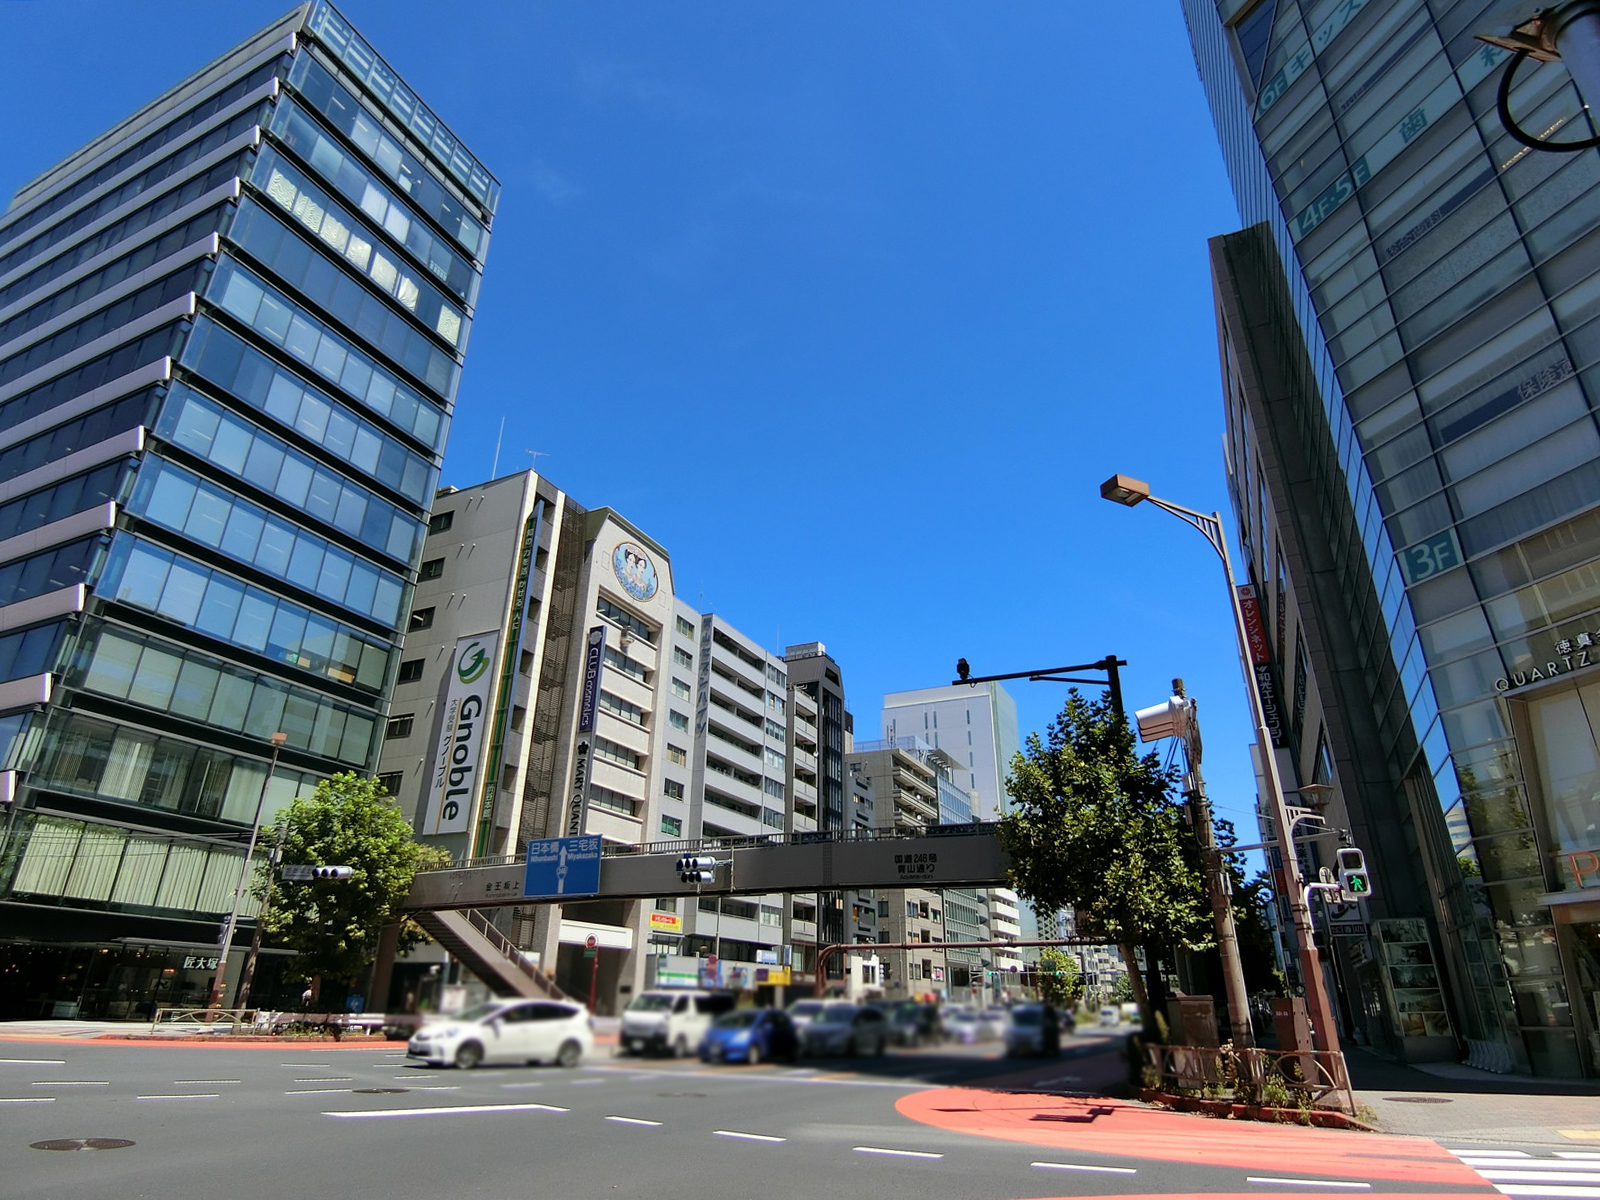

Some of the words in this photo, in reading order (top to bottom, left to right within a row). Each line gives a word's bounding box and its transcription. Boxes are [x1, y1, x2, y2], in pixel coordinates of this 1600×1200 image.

[1260, 74, 1286, 110] 6F
[1412, 542, 1454, 580] 3F
[1242, 599, 1265, 662] オレンジネット
[588, 647, 599, 680] CLUB
[1494, 651, 1591, 691] QUARTZ
[581, 680, 593, 727] cosmetics
[1257, 672, 1282, 746] 和光エージェンシー
[434, 735, 453, 788] グノーブル
[442, 694, 482, 821] Gnoble
[573, 758, 585, 791] MARY
[569, 793, 581, 836] QUANT
[531, 840, 560, 855] 日本橋
[569, 838, 598, 852] 三宅坂
[894, 853, 938, 864] 国道246号
[485, 880, 520, 892] 金王坂上
[897, 863, 936, 874] 青山通り
[183, 956, 219, 970] 匠大塚
